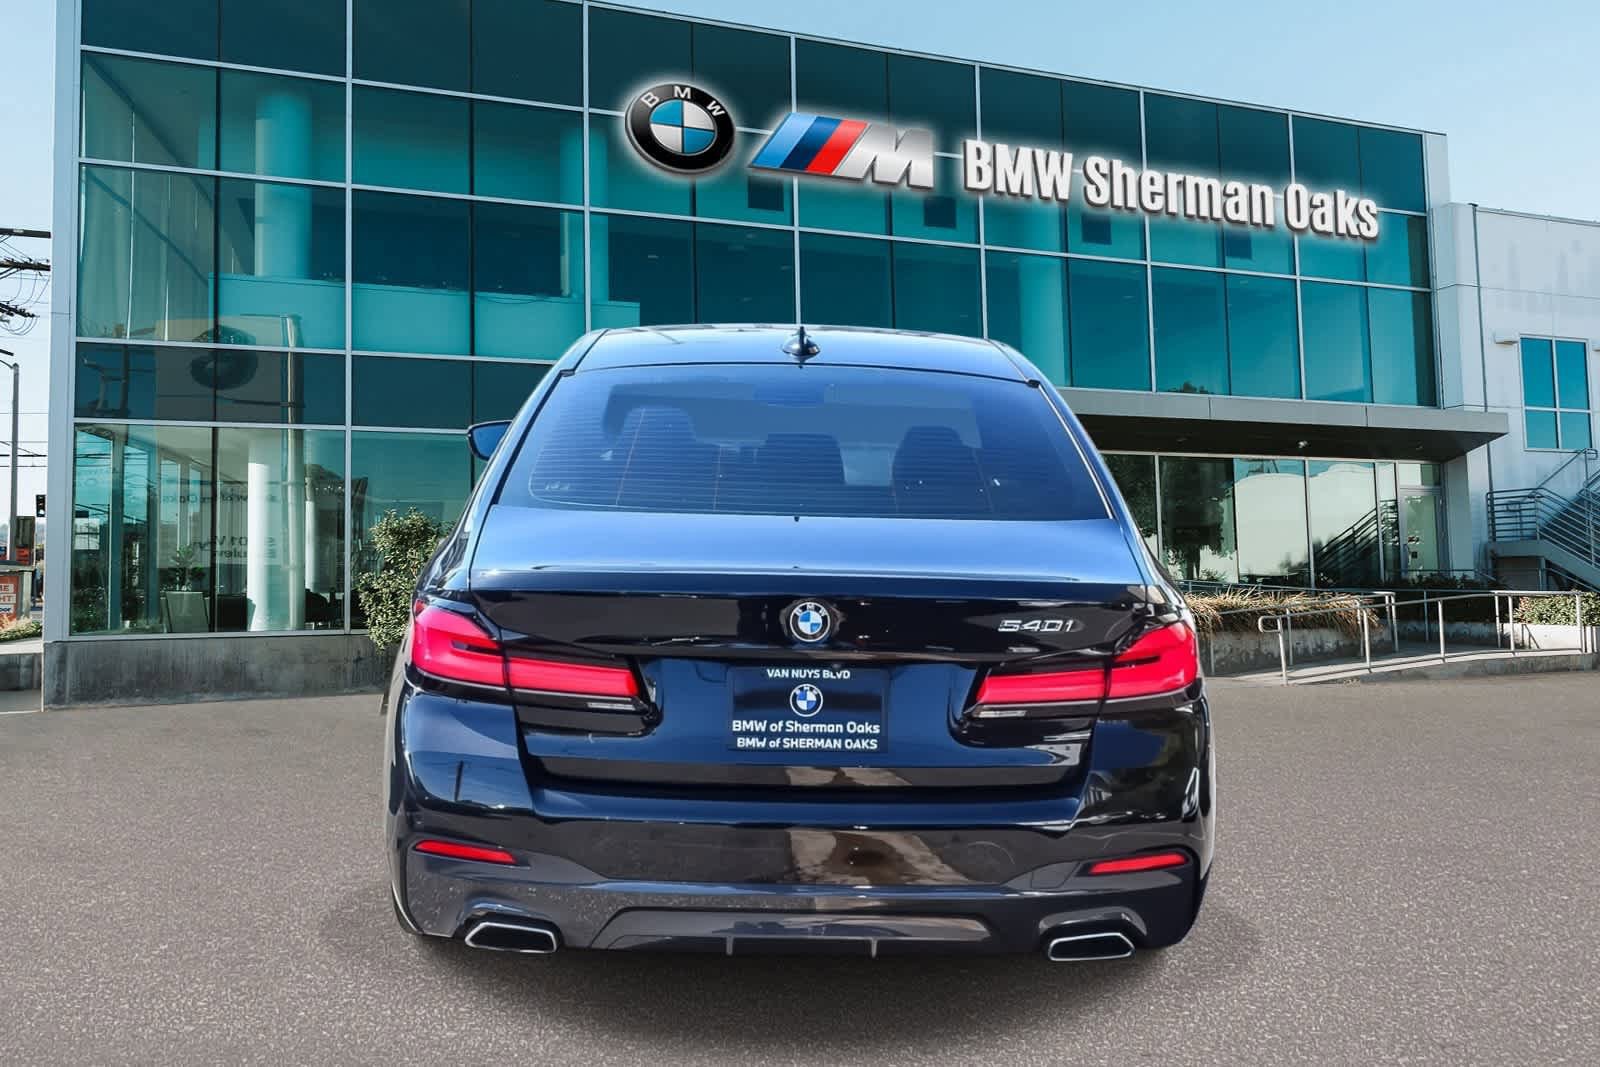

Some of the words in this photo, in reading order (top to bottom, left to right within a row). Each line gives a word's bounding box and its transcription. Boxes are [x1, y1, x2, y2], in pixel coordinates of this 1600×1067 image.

[640, 86, 726, 117] BMW
[963, 138, 1073, 200] BMW
[1083, 155, 1275, 228] Sherman
[1284, 182, 1380, 240] Oaks
[766, 668, 789, 679] VAN
[792, 668, 821, 680] NUYS
[823, 669, 851, 680] BLVD
[732, 720, 768, 732] BMW
[770, 720, 784, 732] of
[785, 721, 844, 734] Sherman
[846, 721, 880, 735] Oaks
[737, 737, 767, 748] BMW
[769, 737, 781, 749] of
[782, 738, 842, 749] SHERMAN
[844, 739, 878, 750] OAKS
